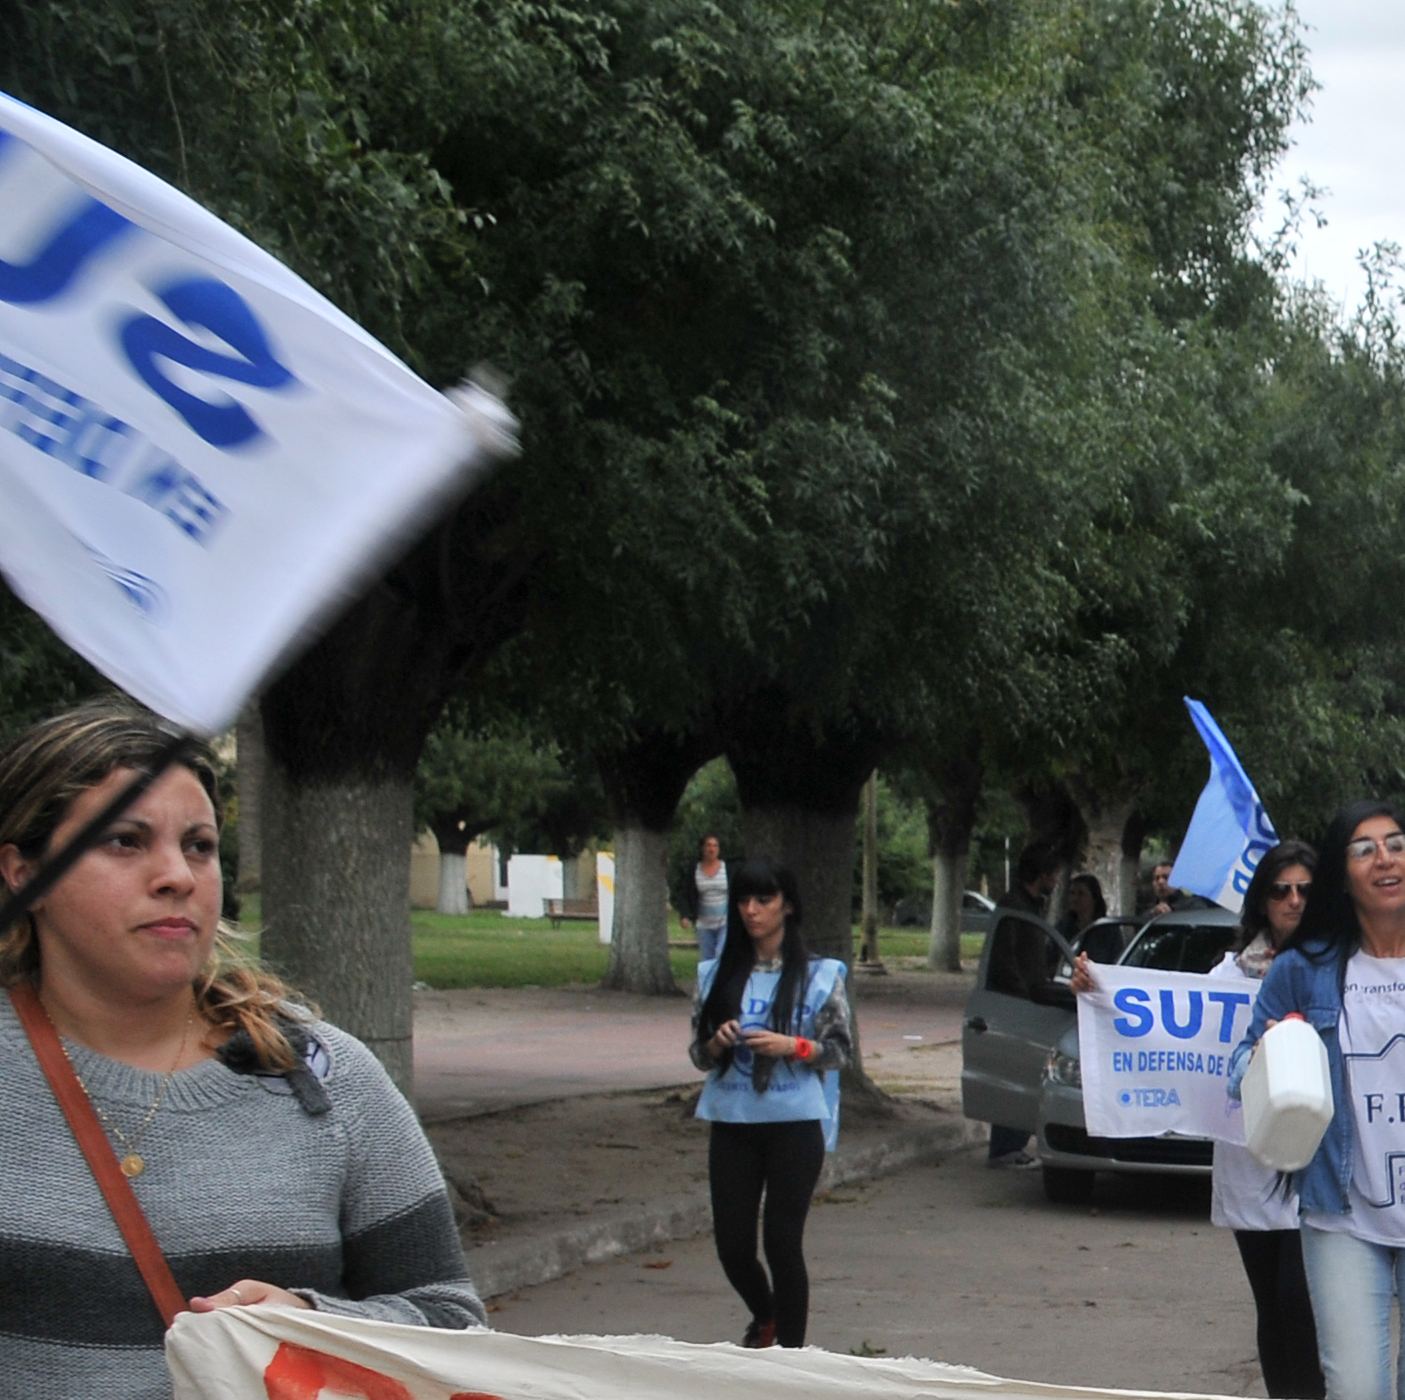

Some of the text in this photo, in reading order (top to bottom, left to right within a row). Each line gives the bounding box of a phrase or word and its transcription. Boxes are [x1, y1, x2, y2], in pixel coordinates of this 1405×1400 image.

[1113, 987, 1250, 1043] SUT
[1113, 1052, 1133, 1072] EN
[1138, 1052, 1204, 1073] DEFENSA
[1208, 1054, 1223, 1077] DE
